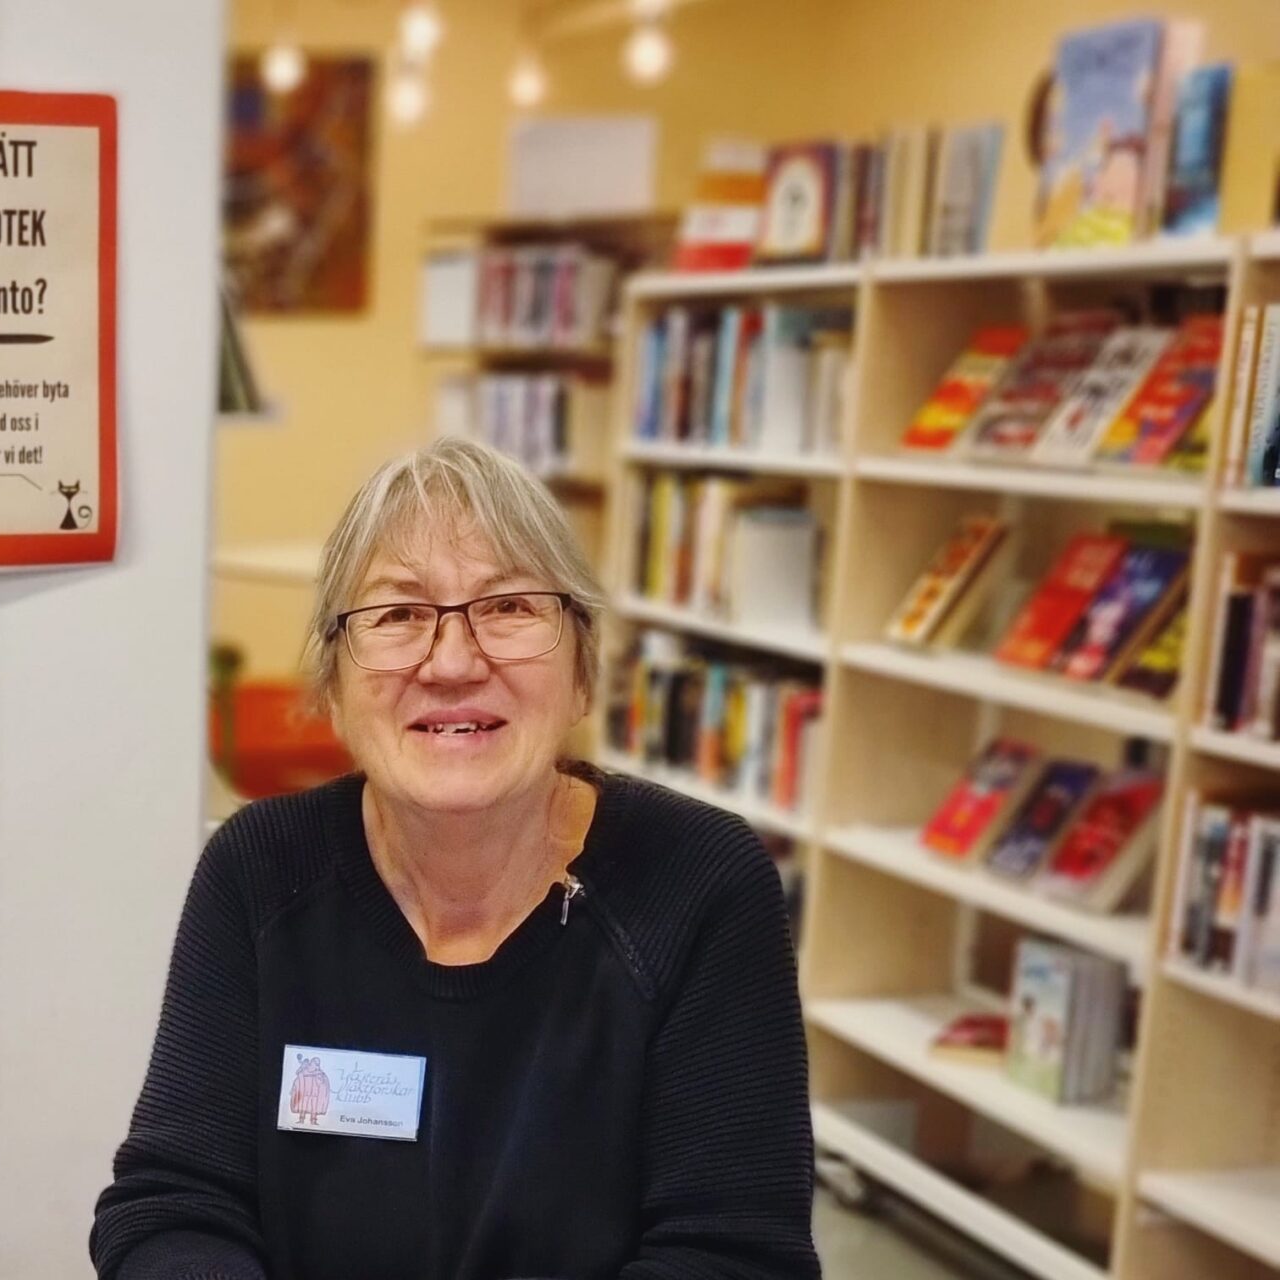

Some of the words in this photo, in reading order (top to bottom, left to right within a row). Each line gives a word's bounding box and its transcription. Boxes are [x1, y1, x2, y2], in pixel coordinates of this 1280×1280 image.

[42, 380, 70, 404] byta
[10, 416, 32, 432] oss
[3, 446, 16, 465] vi
[18, 445, 43, 465] det!
[339, 1114, 356, 1124] Eva
[357, 1115, 404, 1127] Johansson
